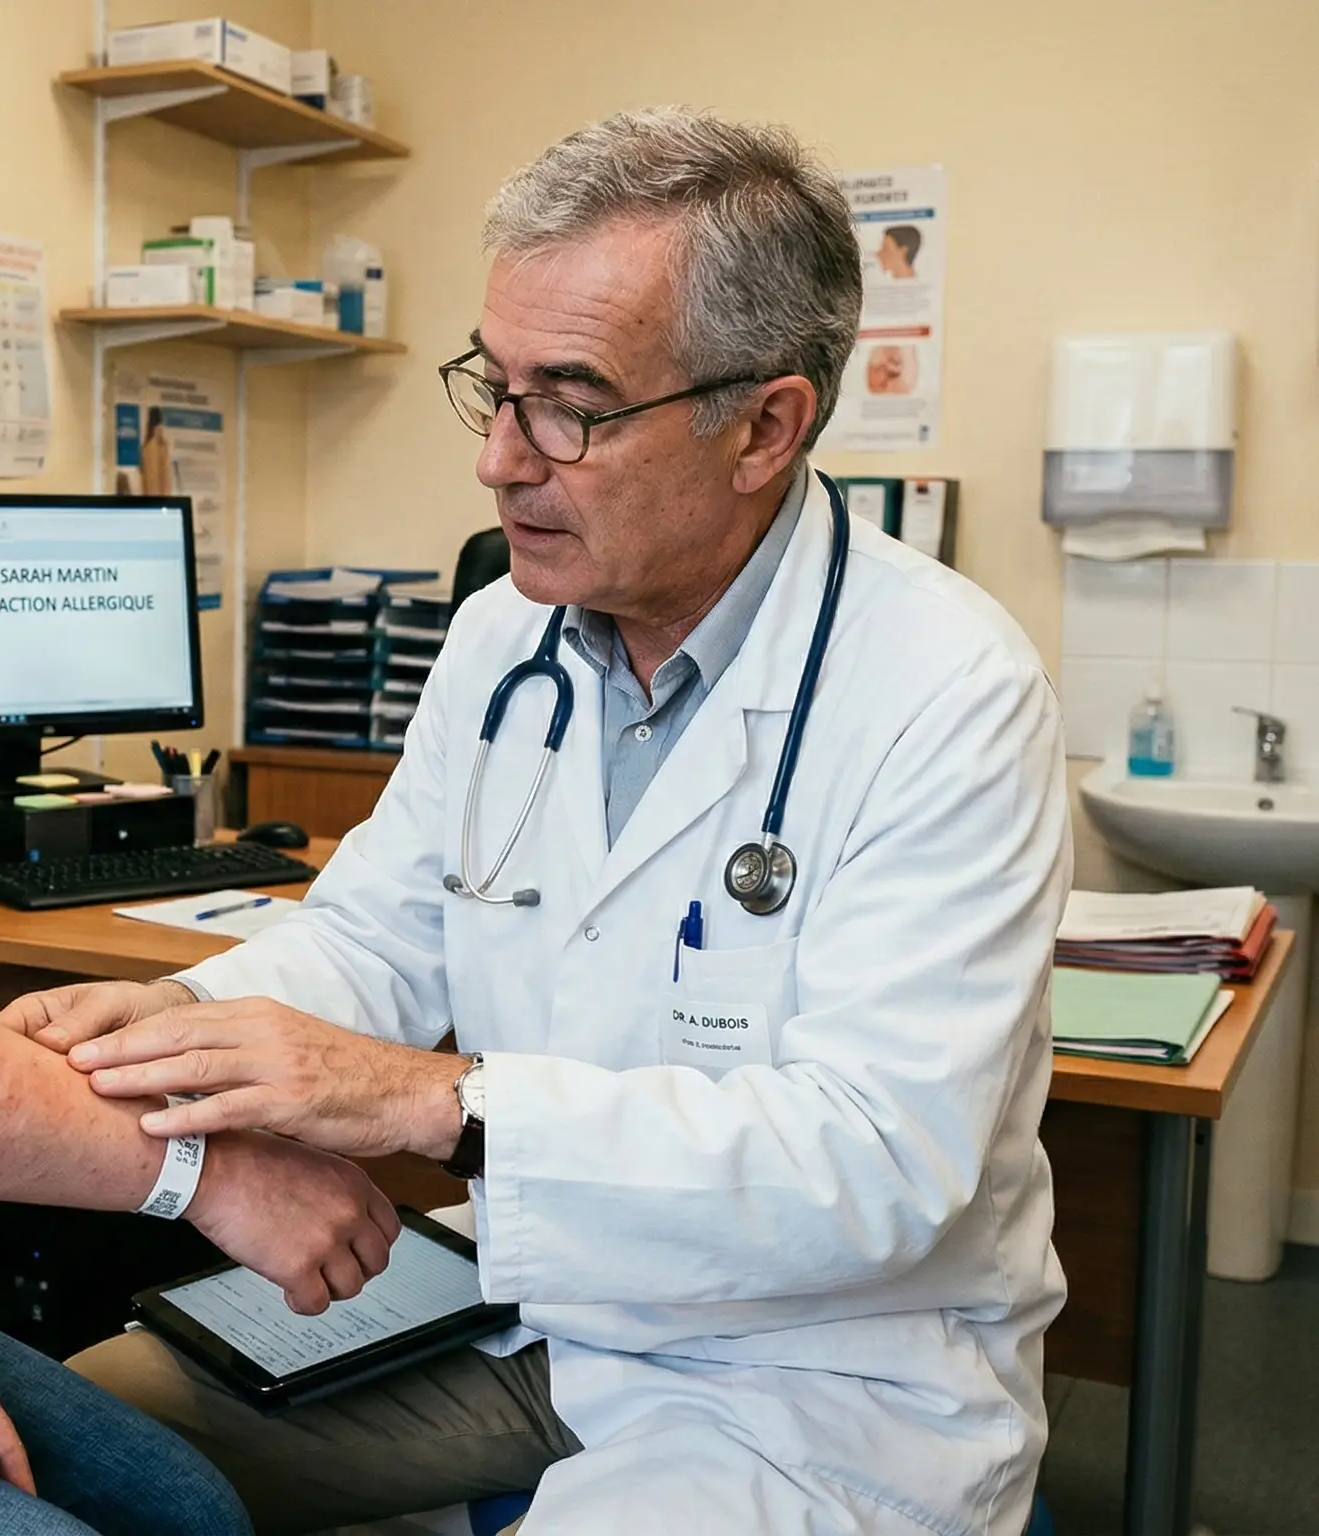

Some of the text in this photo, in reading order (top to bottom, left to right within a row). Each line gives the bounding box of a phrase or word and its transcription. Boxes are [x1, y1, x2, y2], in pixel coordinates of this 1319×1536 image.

[0, 569, 52, 584] SARAH
[57, 567, 118, 583] MARTIN
[63, 595, 154, 612] ALLERGIQUE
[689, 1015, 699, 1026] A.
[701, 1016, 749, 1029] DUBOIS
